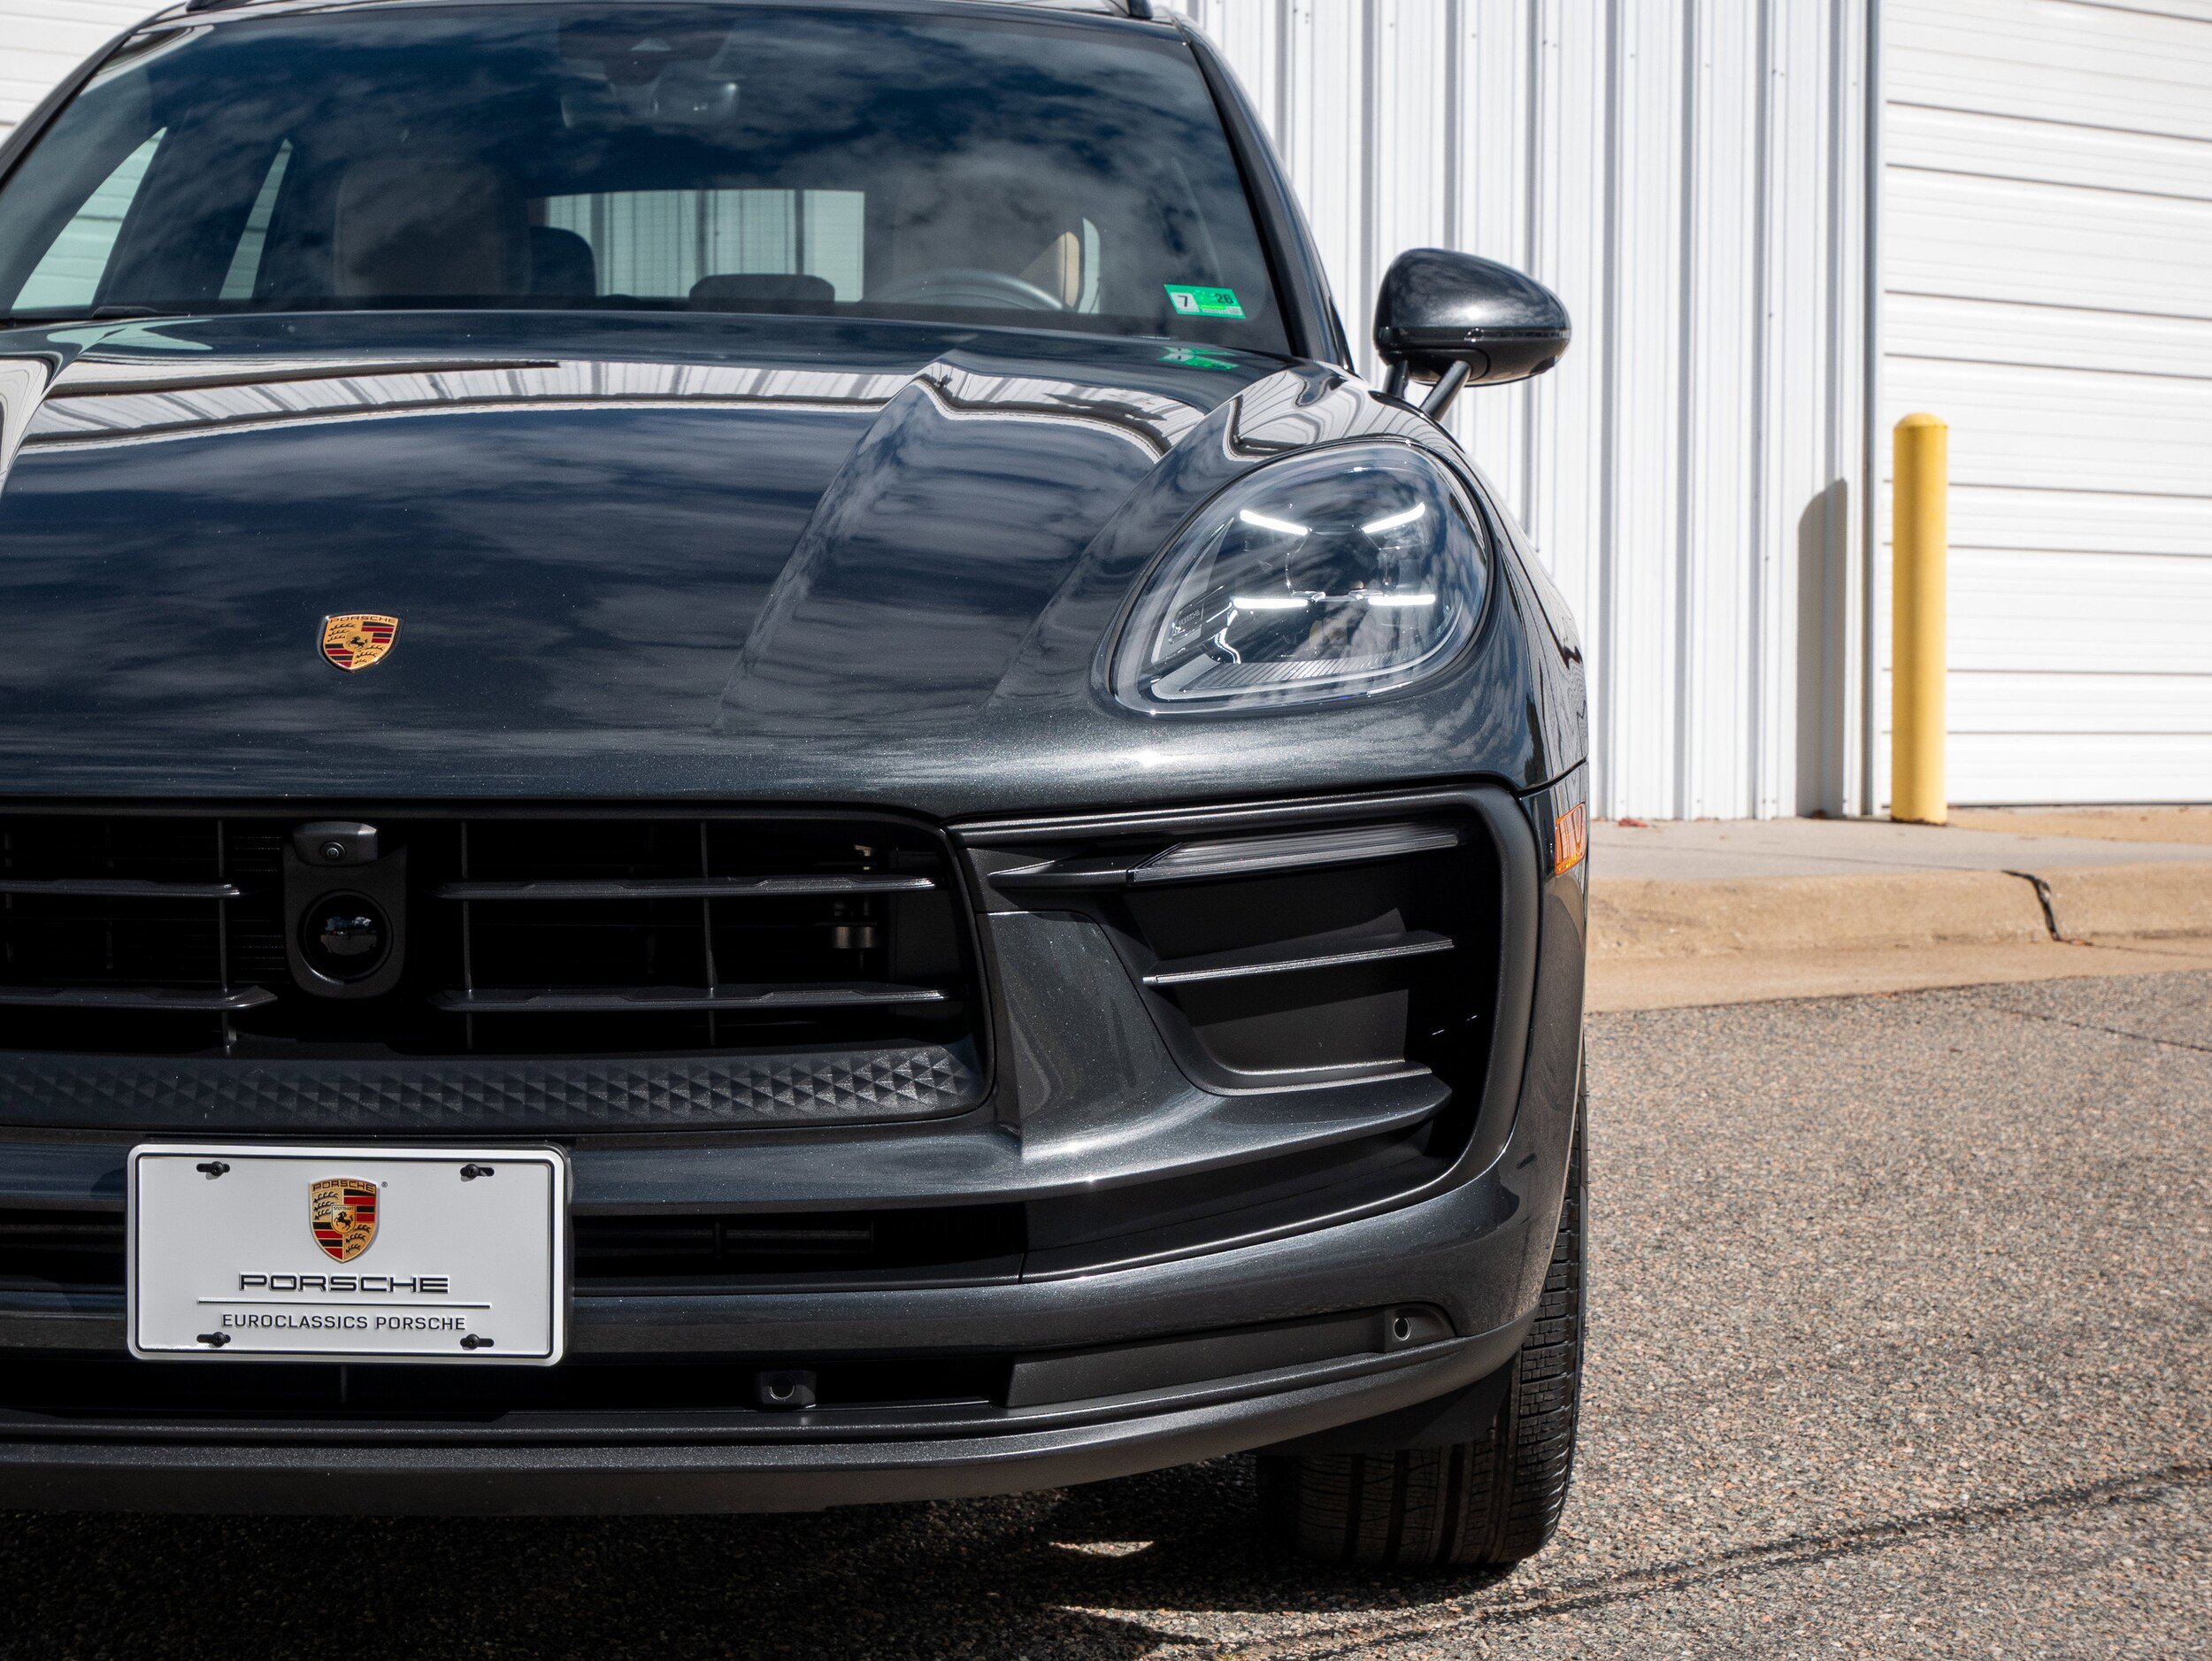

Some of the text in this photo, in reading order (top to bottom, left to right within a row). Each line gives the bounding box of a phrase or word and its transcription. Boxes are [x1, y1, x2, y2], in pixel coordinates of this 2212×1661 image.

[1178, 293, 1234, 307] 7 26
[330, 615, 396, 624] PORSCHE
[312, 1180, 376, 1194] PORSCHE
[239, 1273, 449, 1294] PORSCHE
[221, 1313, 466, 1331] EUROCLASSICS PORSCHE
